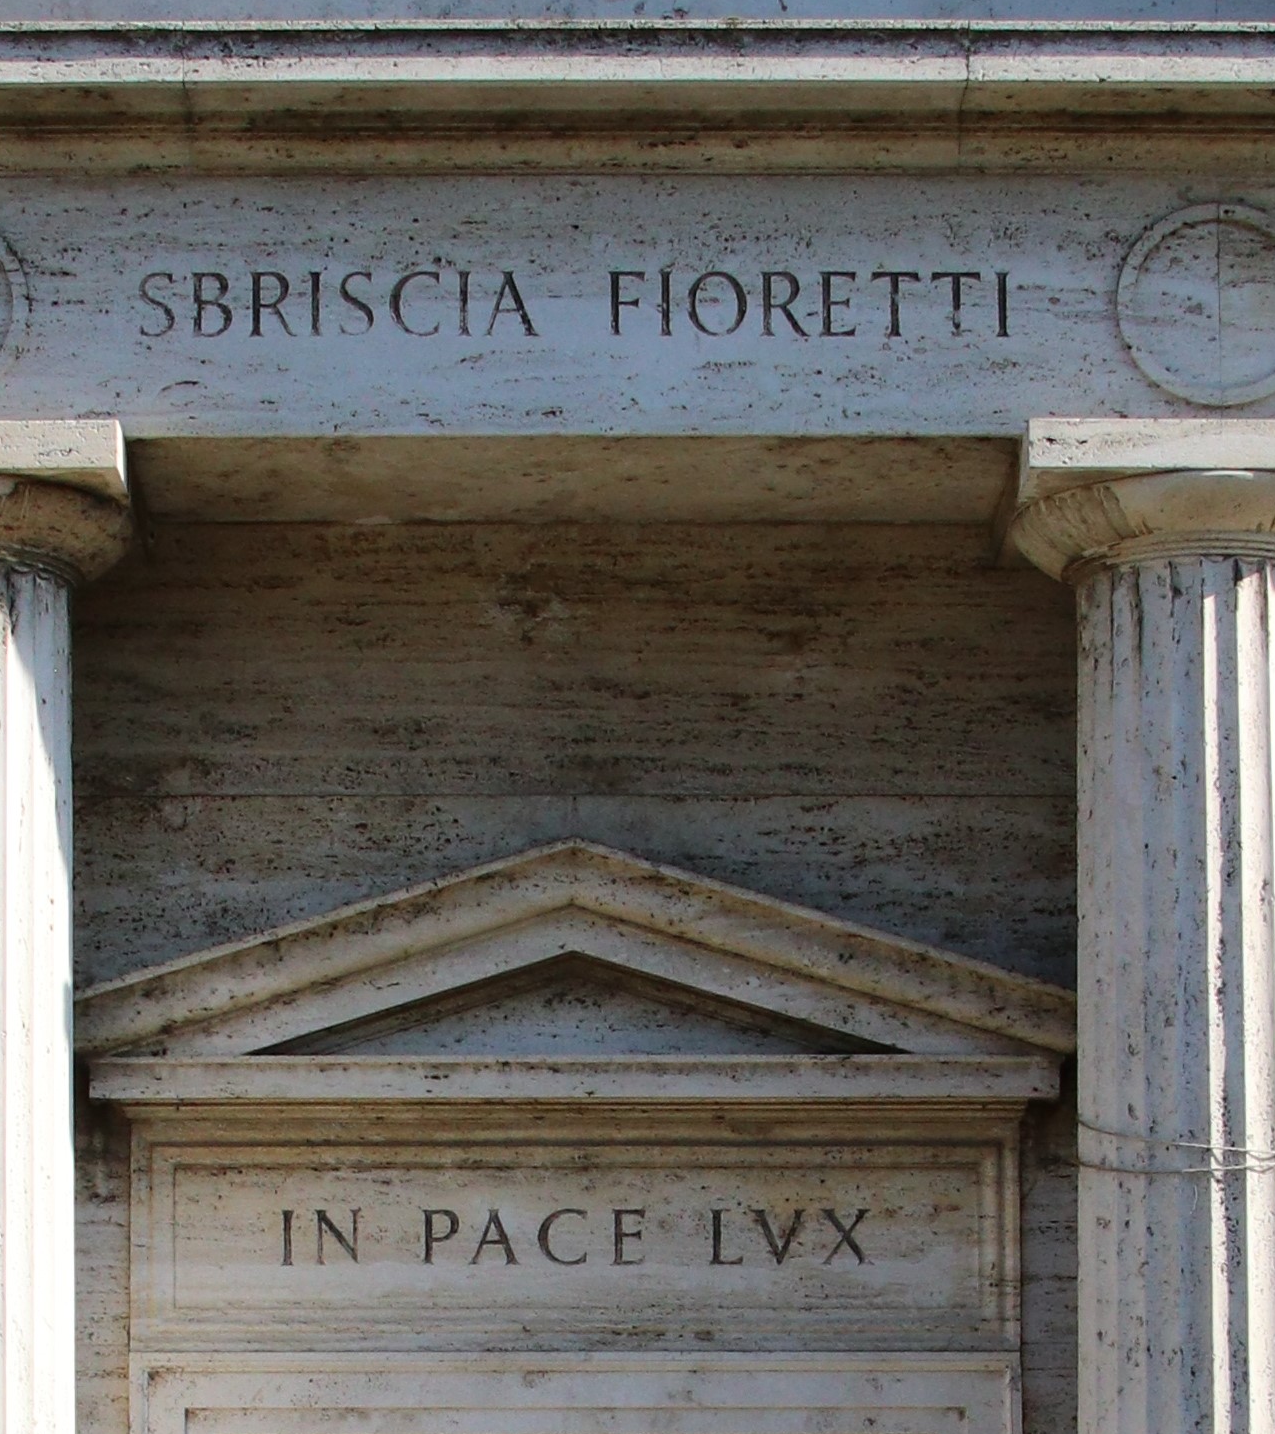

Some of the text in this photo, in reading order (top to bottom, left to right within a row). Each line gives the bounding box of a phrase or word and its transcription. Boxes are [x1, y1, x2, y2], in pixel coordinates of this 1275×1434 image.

[137, 270, 541, 338] SBRISCIA
[609, 269, 1011, 338] FIORETTI
[280, 1208, 875, 1266] IN PACE LVX
